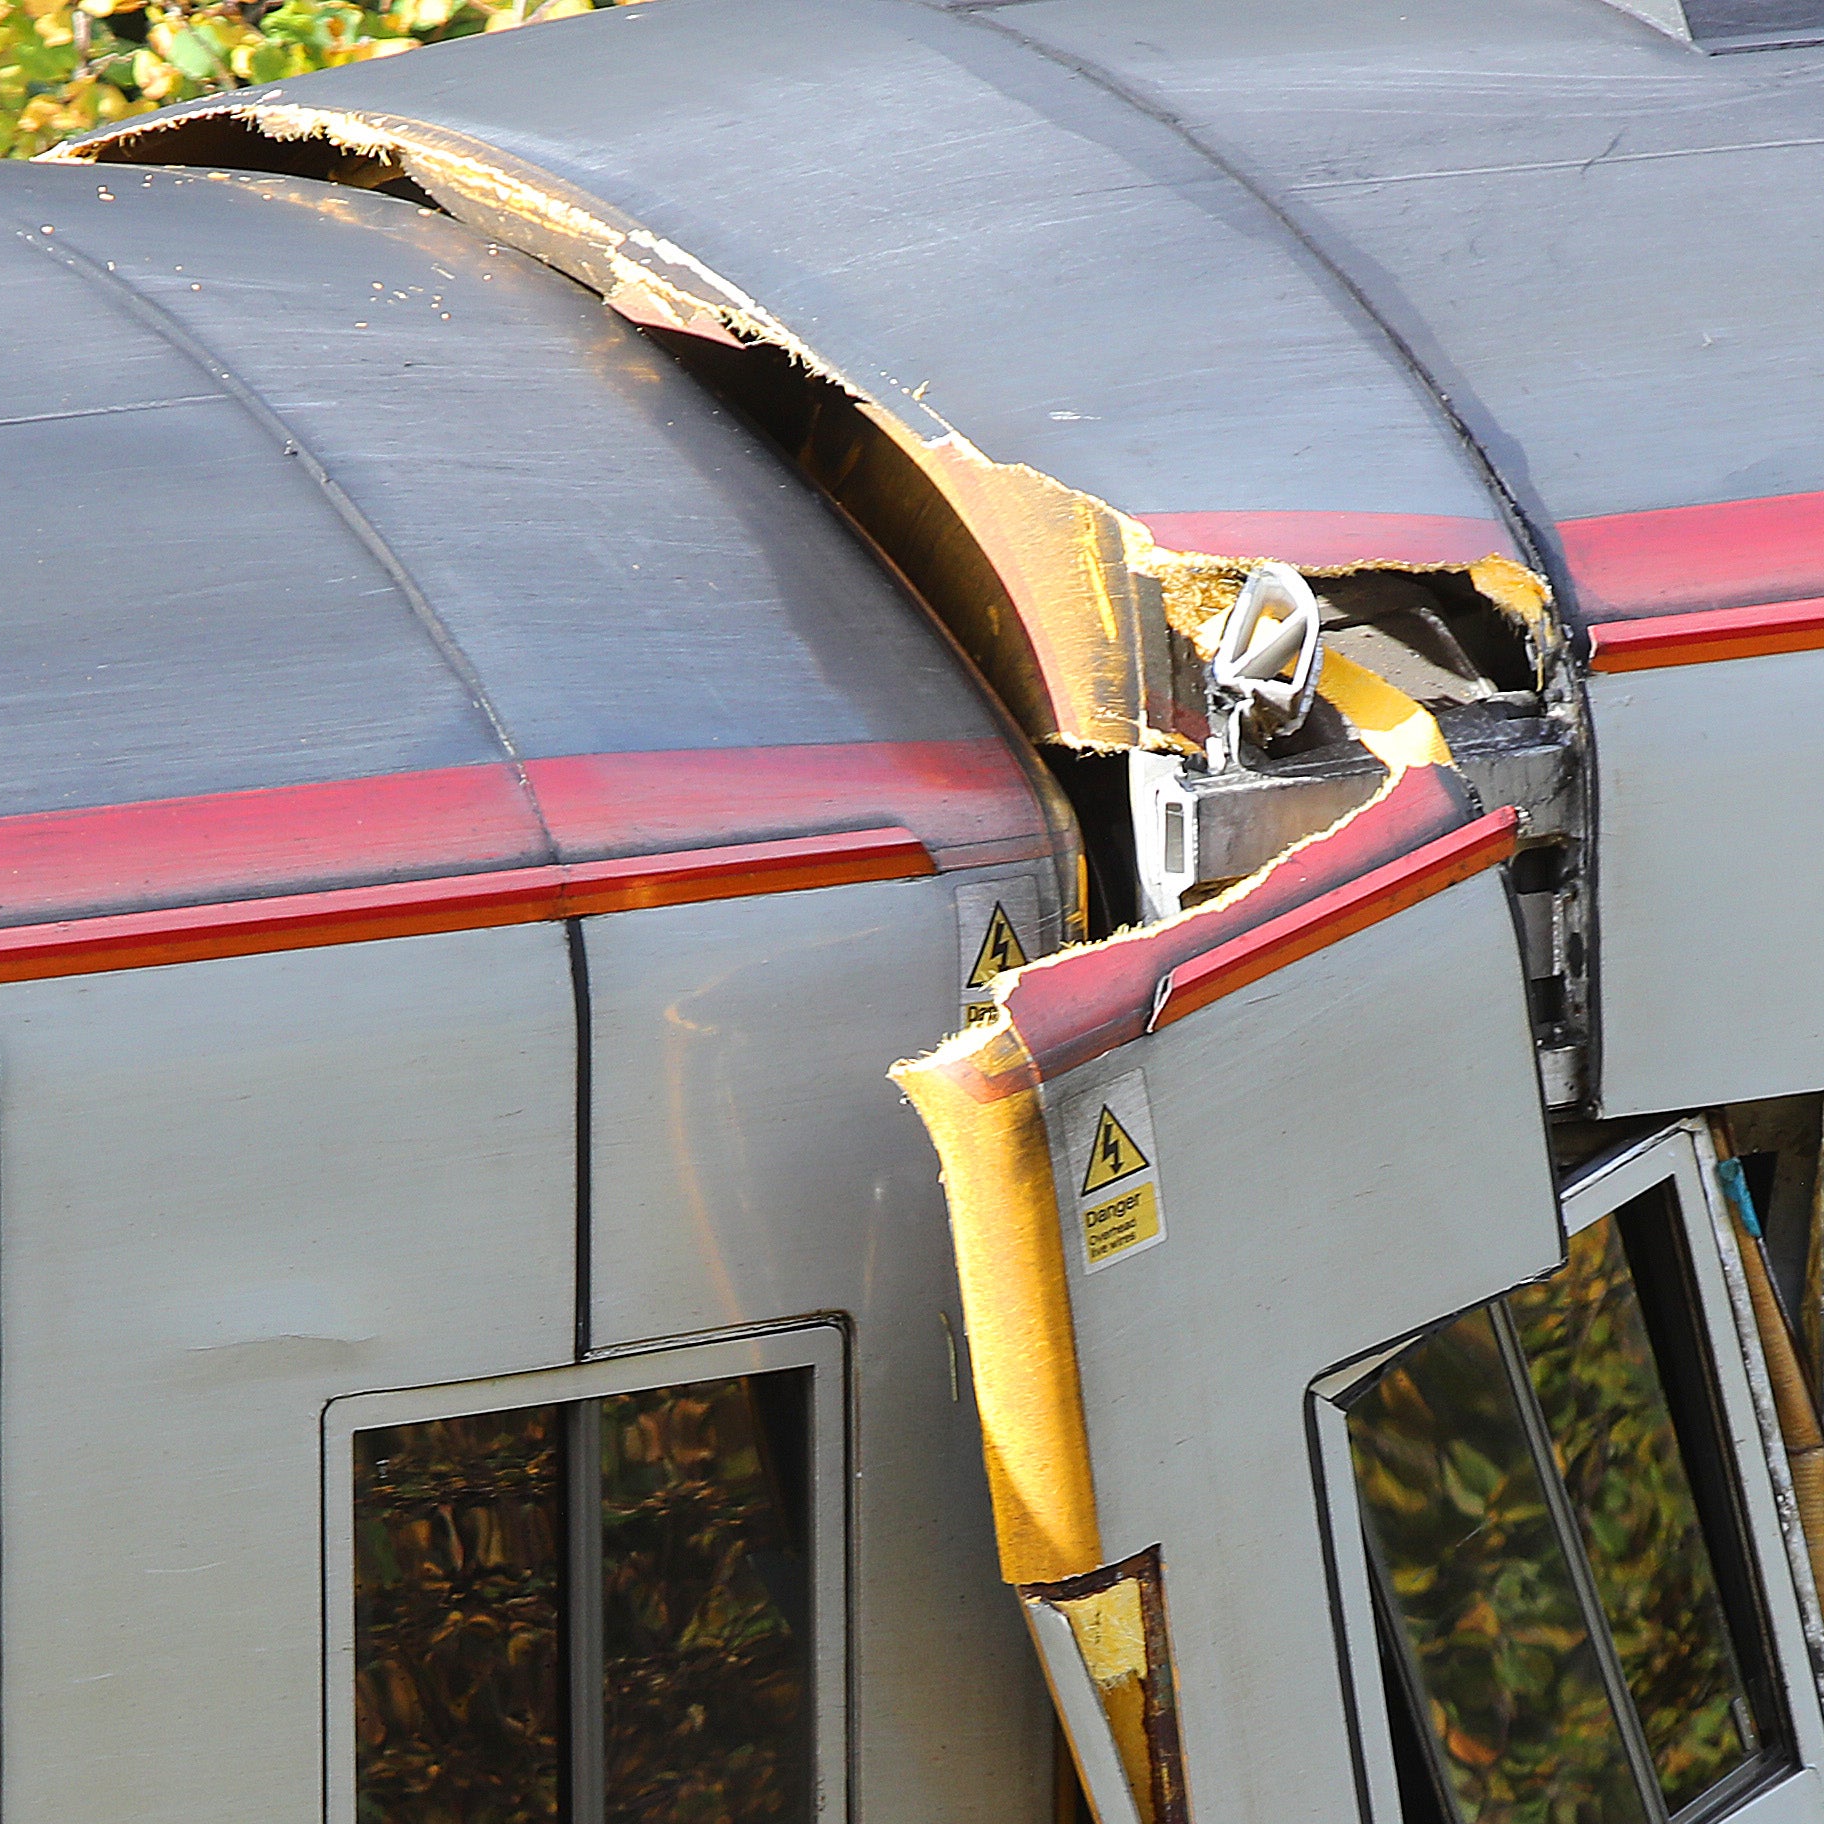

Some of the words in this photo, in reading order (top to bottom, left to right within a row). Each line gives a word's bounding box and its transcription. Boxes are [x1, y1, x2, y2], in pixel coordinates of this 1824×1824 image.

[1086, 1192, 1142, 1228] Danger
[1089, 1217, 1137, 1246] Overhead
[1110, 1231, 1136, 1249] wires
